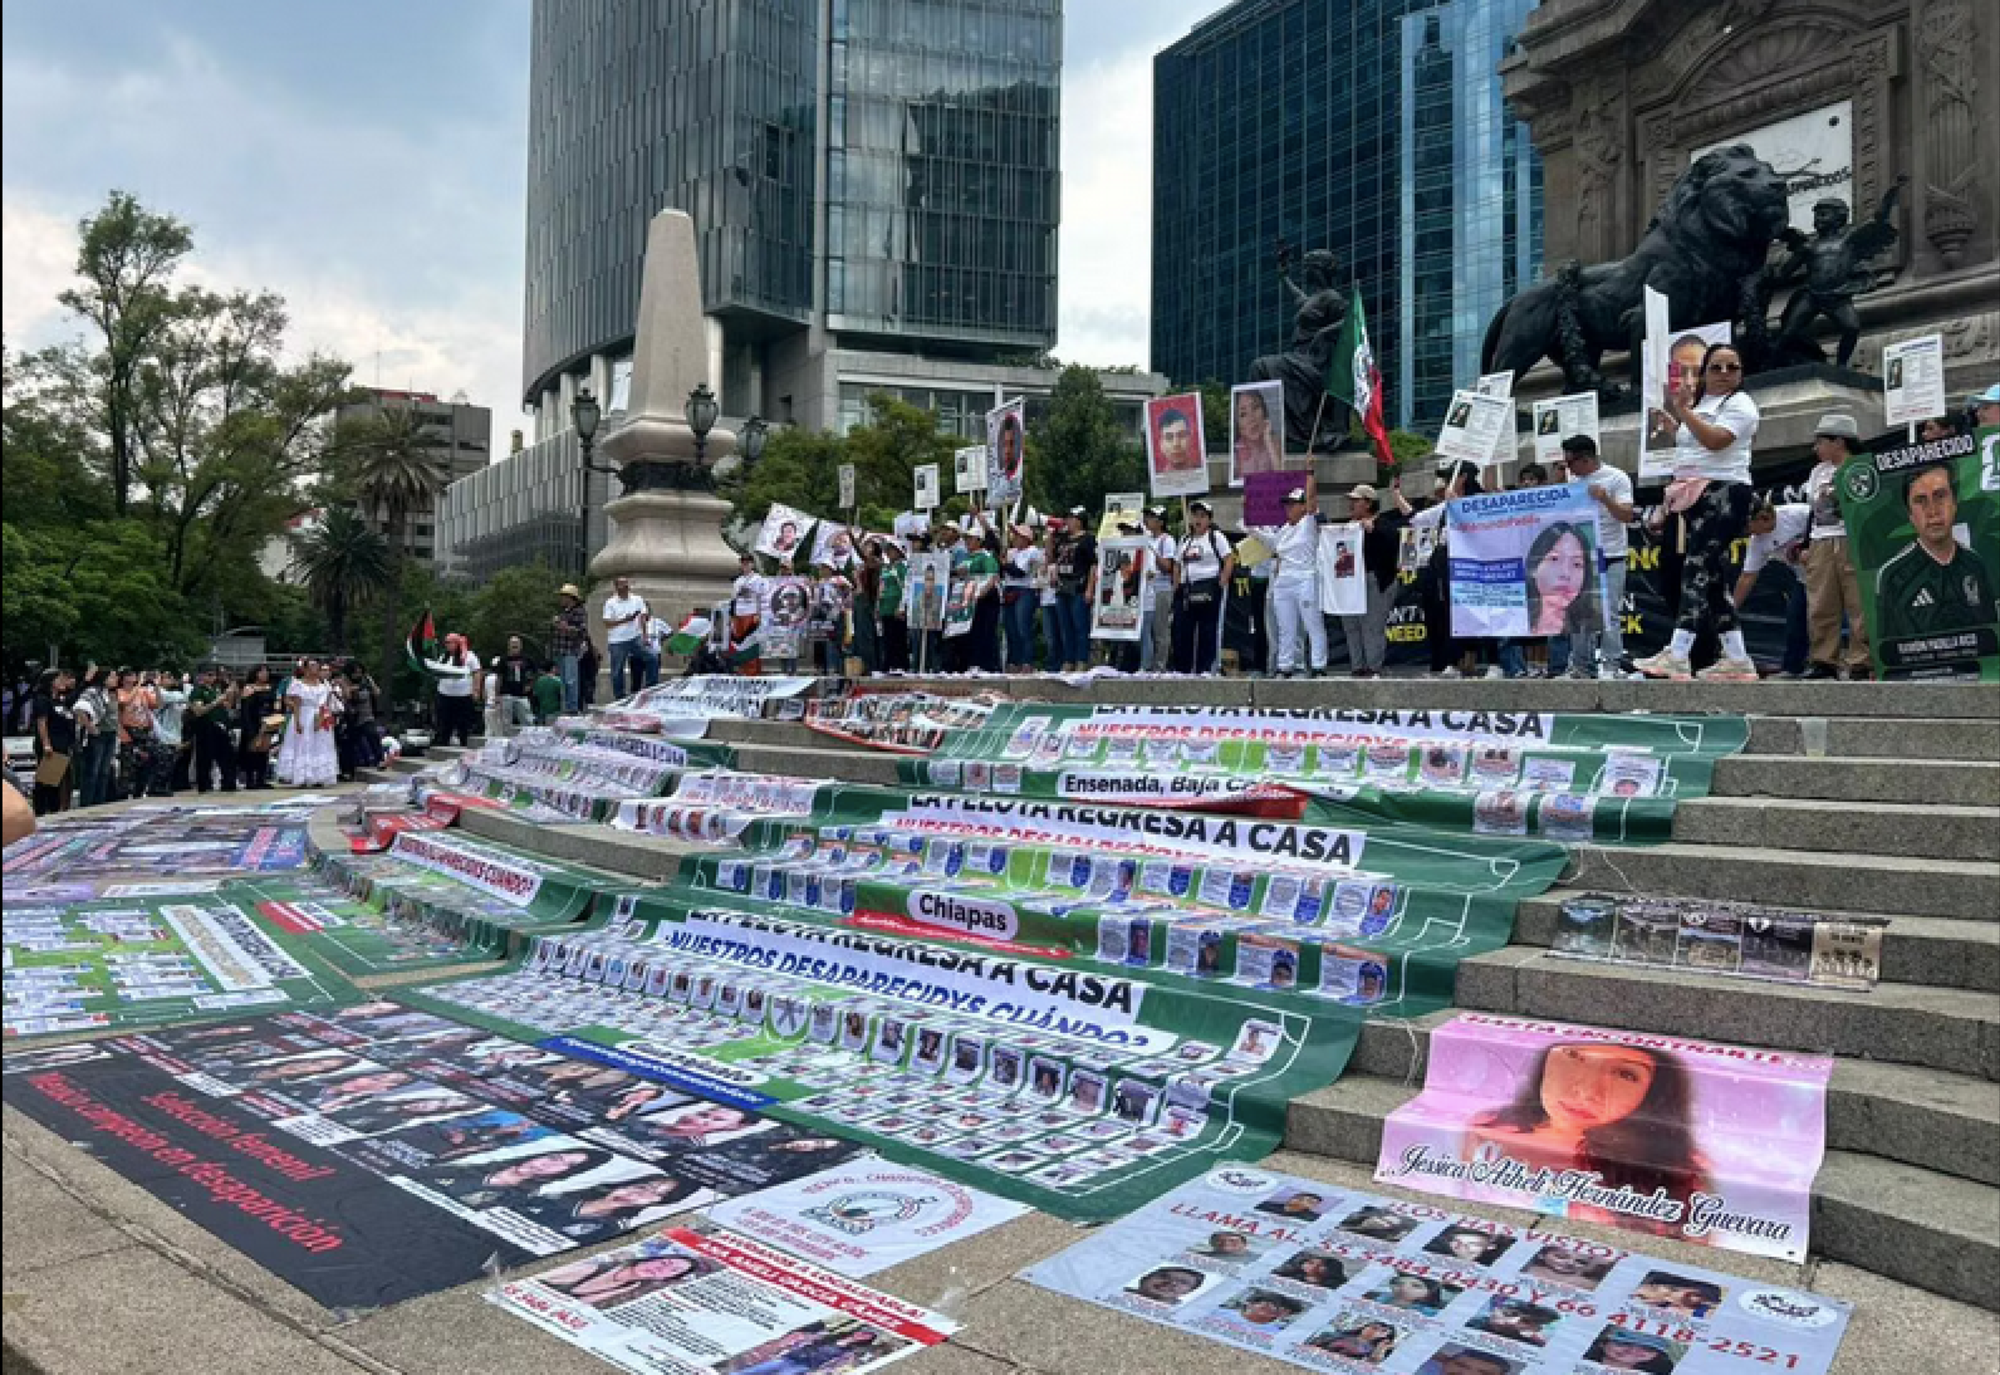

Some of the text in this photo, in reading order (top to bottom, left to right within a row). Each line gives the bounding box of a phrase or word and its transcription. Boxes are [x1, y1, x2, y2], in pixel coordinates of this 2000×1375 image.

[1875, 434, 1974, 472] DESAPARECIDO
[1461, 487, 1571, 514] DESAPARECIDA
[1407, 709, 1432, 729] A
[1442, 709, 1543, 738] CASA
[1065, 773, 1165, 796] Ensenada,
[1170, 774, 1220, 797] Baja
[1213, 819, 1238, 848] A
[1247, 823, 1351, 866] CASA
[919, 892, 1007, 932] Chiapas
[988, 962, 1018, 986] A
[1025, 967, 1132, 1014] CASA
[1394, 1143, 1466, 1179] Jessica
[1554, 1170, 1685, 1223] Hernández
[1687, 1193, 1794, 1241] Guevara
[1458, 1217, 1514, 1236] HAS
[1170, 1203, 1261, 1233] LLAMA
[1608, 1313, 1801, 1370] 4118-2521
